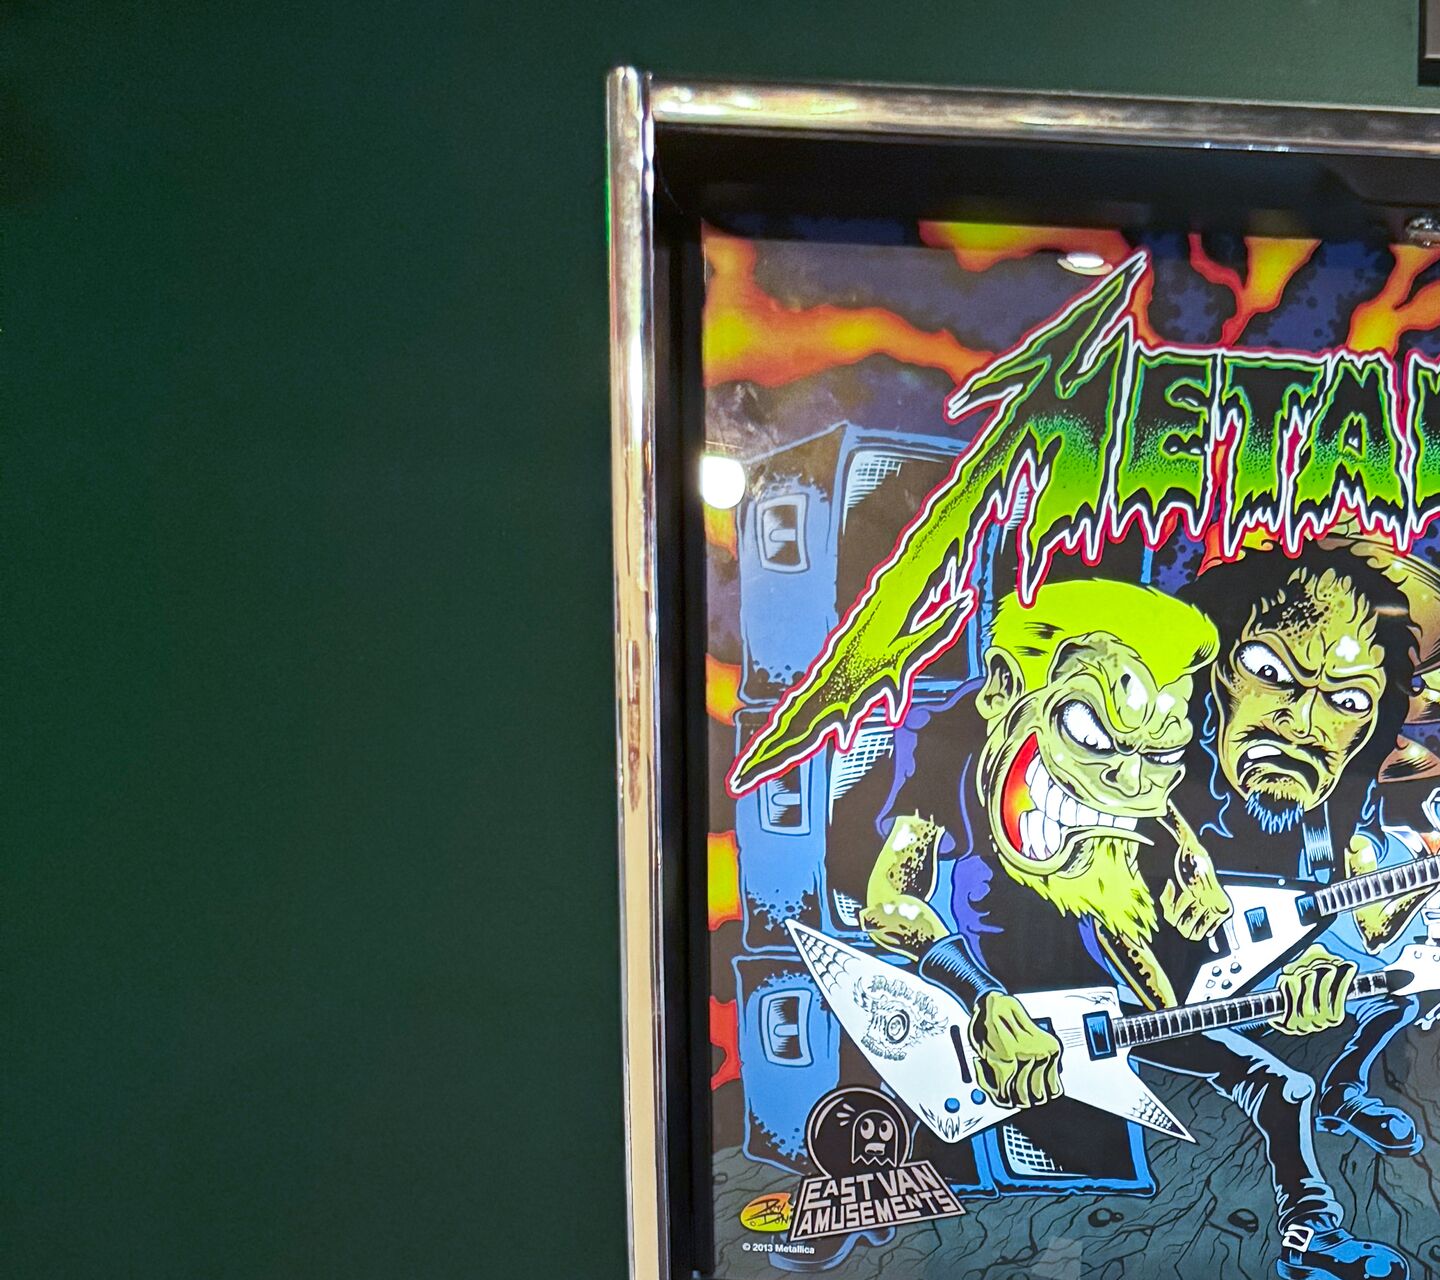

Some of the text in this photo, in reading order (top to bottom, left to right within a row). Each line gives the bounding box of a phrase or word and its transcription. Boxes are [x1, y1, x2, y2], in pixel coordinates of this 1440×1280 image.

[803, 1165, 941, 1209] EAST VAN
[798, 1191, 955, 1236] AMUSEMENTS
[752, 1242, 773, 1252] 2013
[775, 1243, 815, 1254] Metallica
